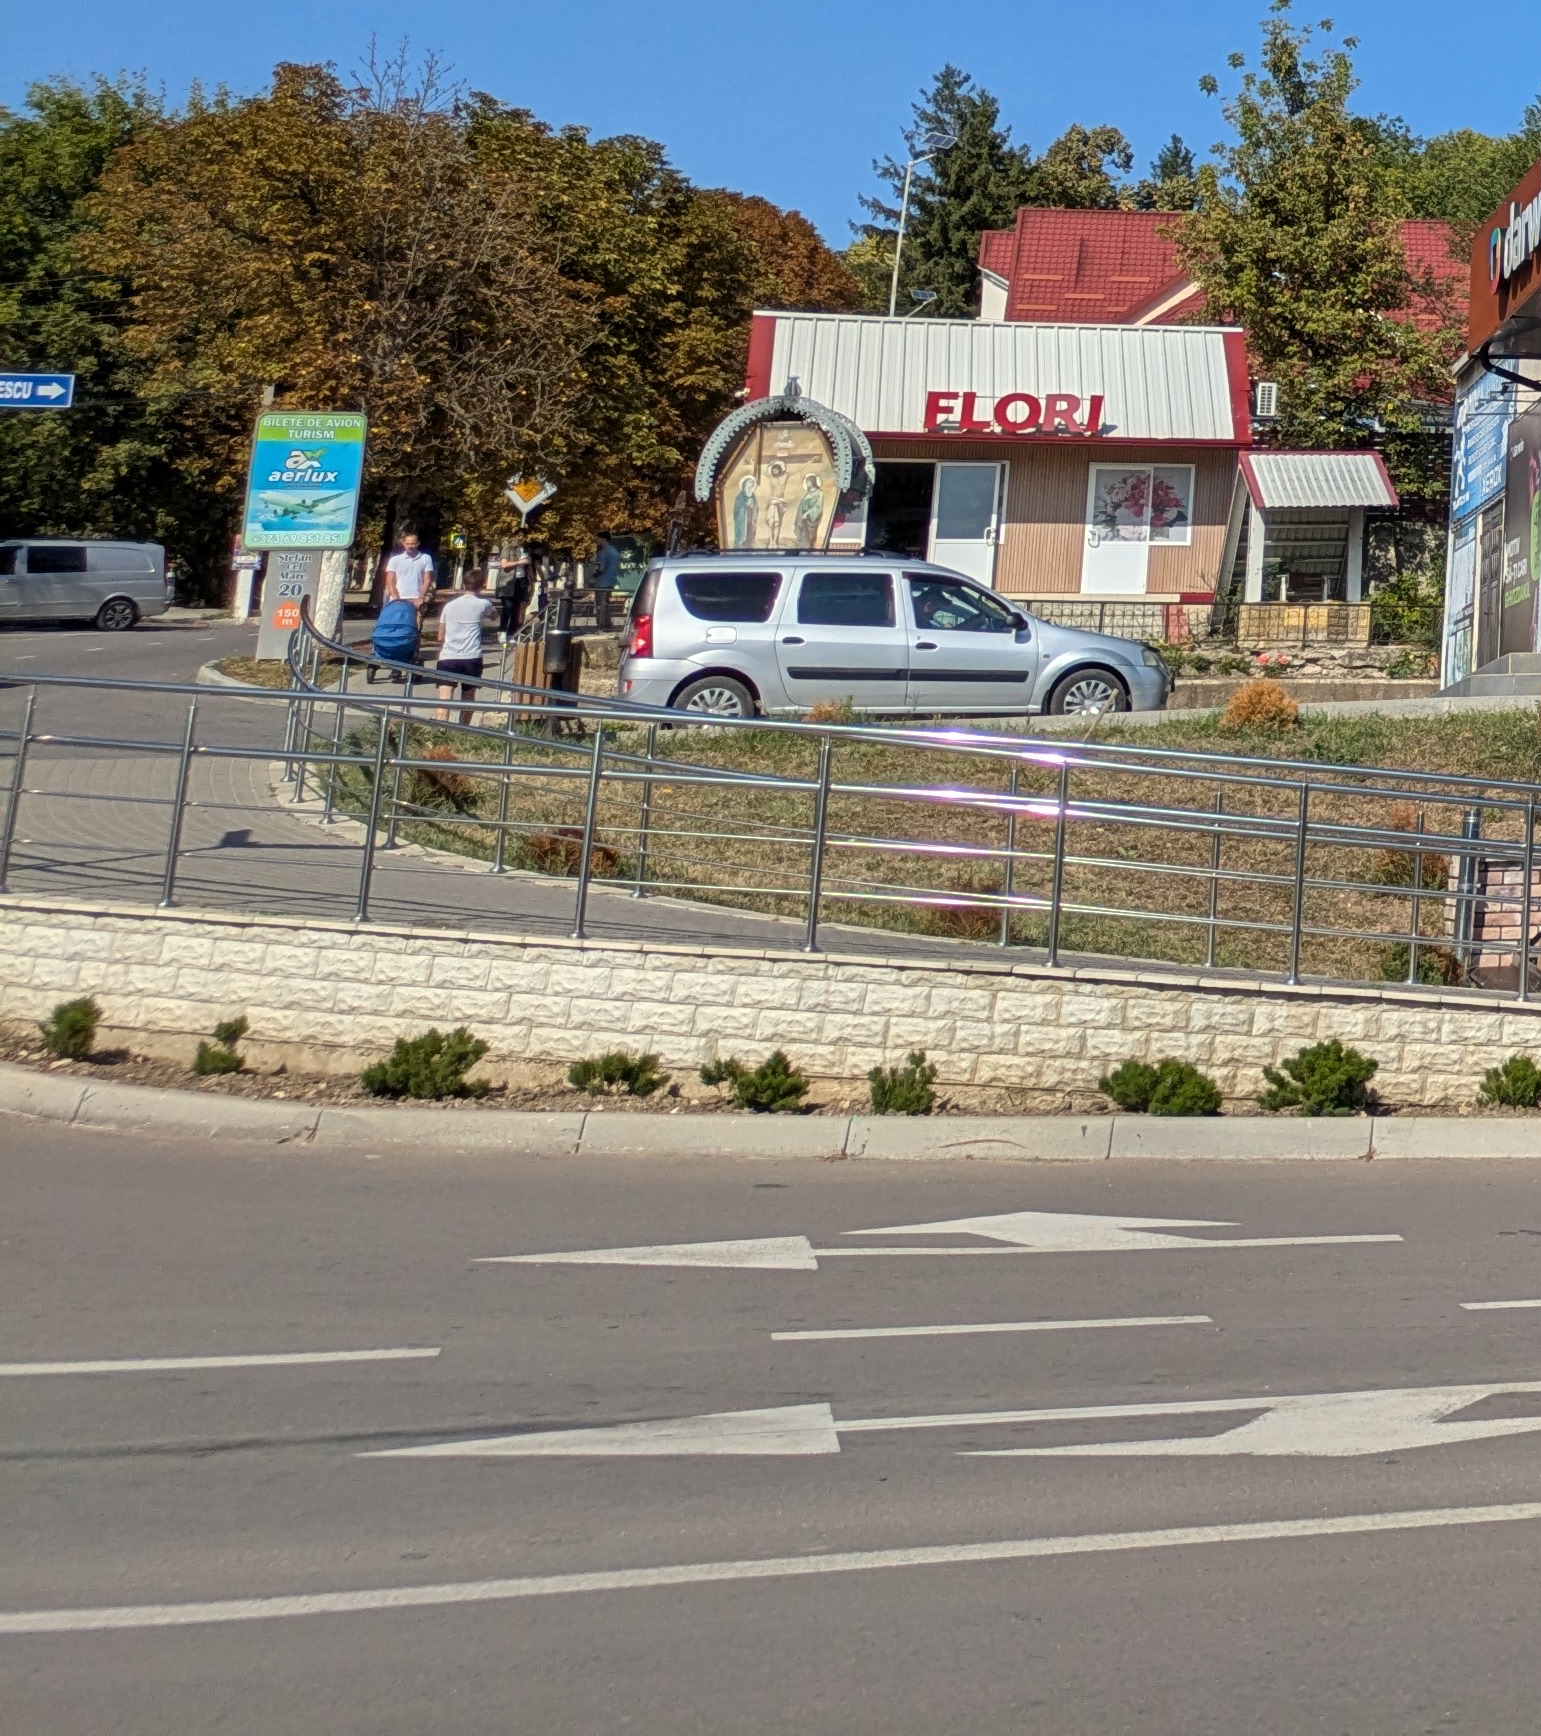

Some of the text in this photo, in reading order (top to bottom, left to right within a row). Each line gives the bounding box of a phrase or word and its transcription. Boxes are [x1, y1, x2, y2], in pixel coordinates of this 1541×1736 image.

[923, 391, 1104, 432] FLORI
[263, 417, 361, 428] BILETE DE AVION
[288, 429, 335, 439] TURISM
[268, 469, 339, 482] aerlux
[283, 534, 297, 543] 69
[300, 534, 320, 543] 851
[324, 534, 343, 543] 851
[278, 584, 302, 596] 20
[277, 609, 299, 618] 150
